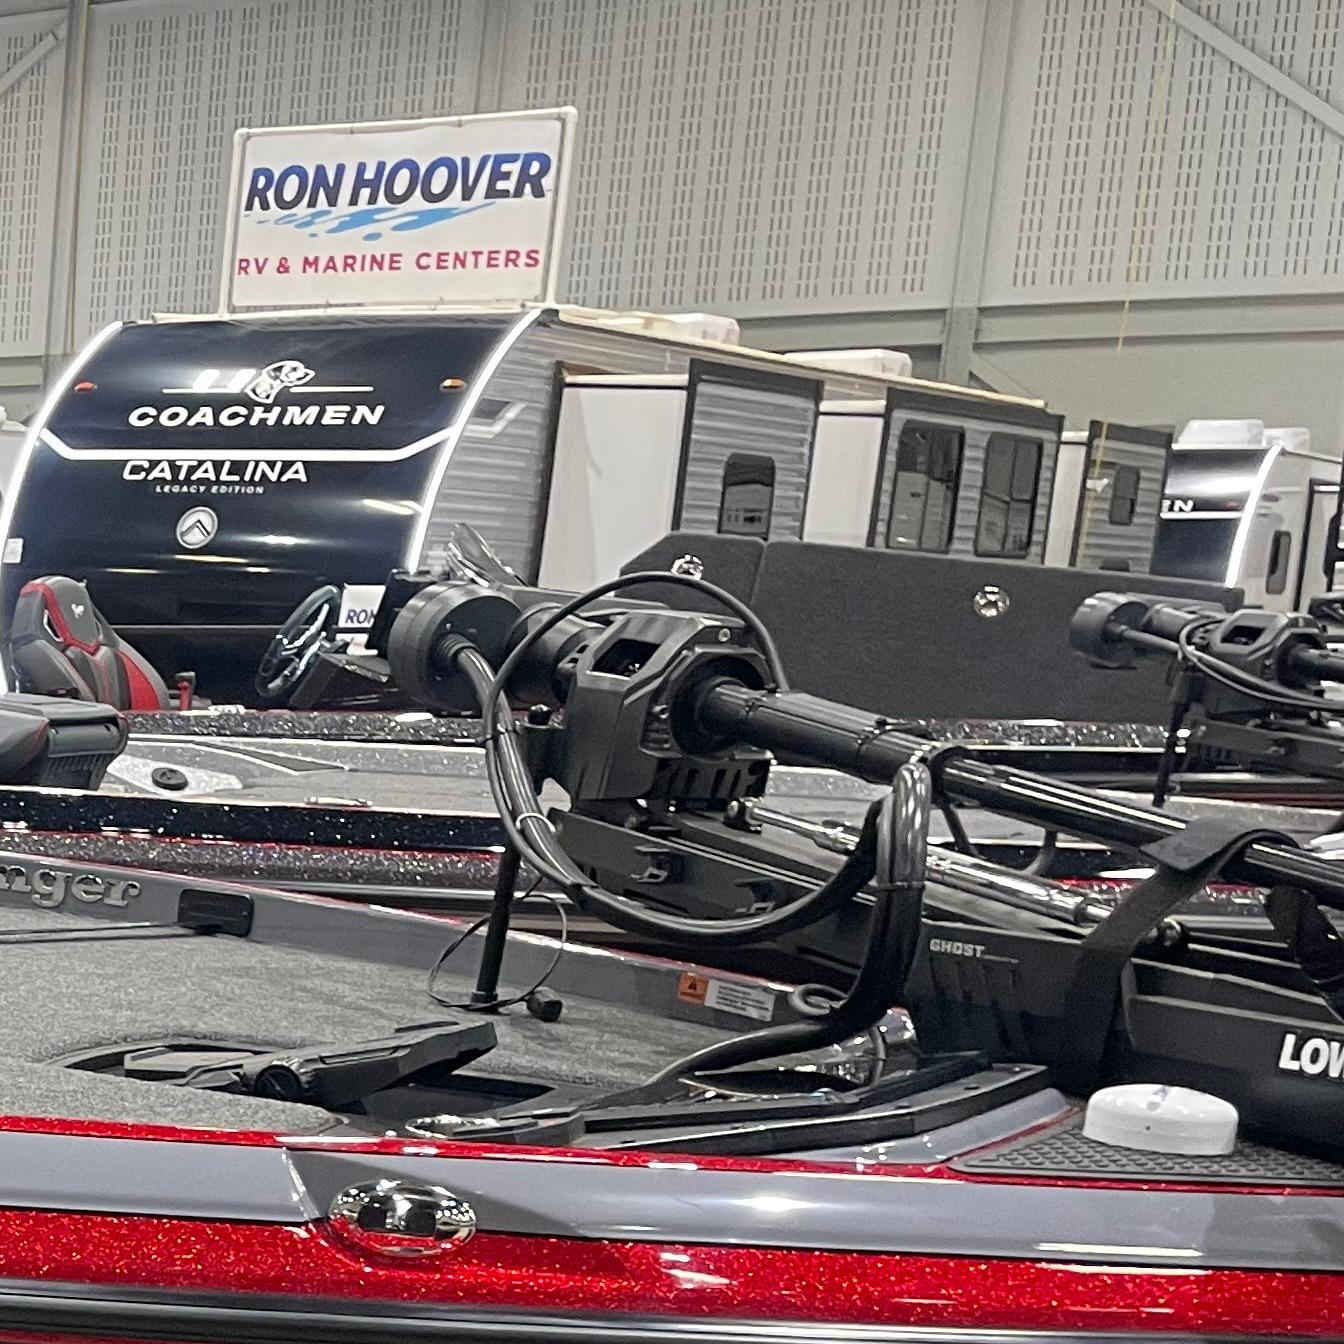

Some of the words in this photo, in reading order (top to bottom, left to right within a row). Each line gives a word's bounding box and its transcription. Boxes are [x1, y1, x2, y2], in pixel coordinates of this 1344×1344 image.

[244, 163, 345, 212] RON
[348, 152, 552, 207] HOOVER
[238, 258, 268, 275] RV
[276, 256, 291, 274] &
[302, 253, 402, 273] MARINE
[415, 249, 540, 270] CENTERS
[127, 405, 386, 427] COACHMEN
[122, 460, 308, 482] CATALINA
[156, 484, 206, 494] LEGACY
[211, 485, 264, 495] EDITION
[929, 938, 985, 959] GHOST
